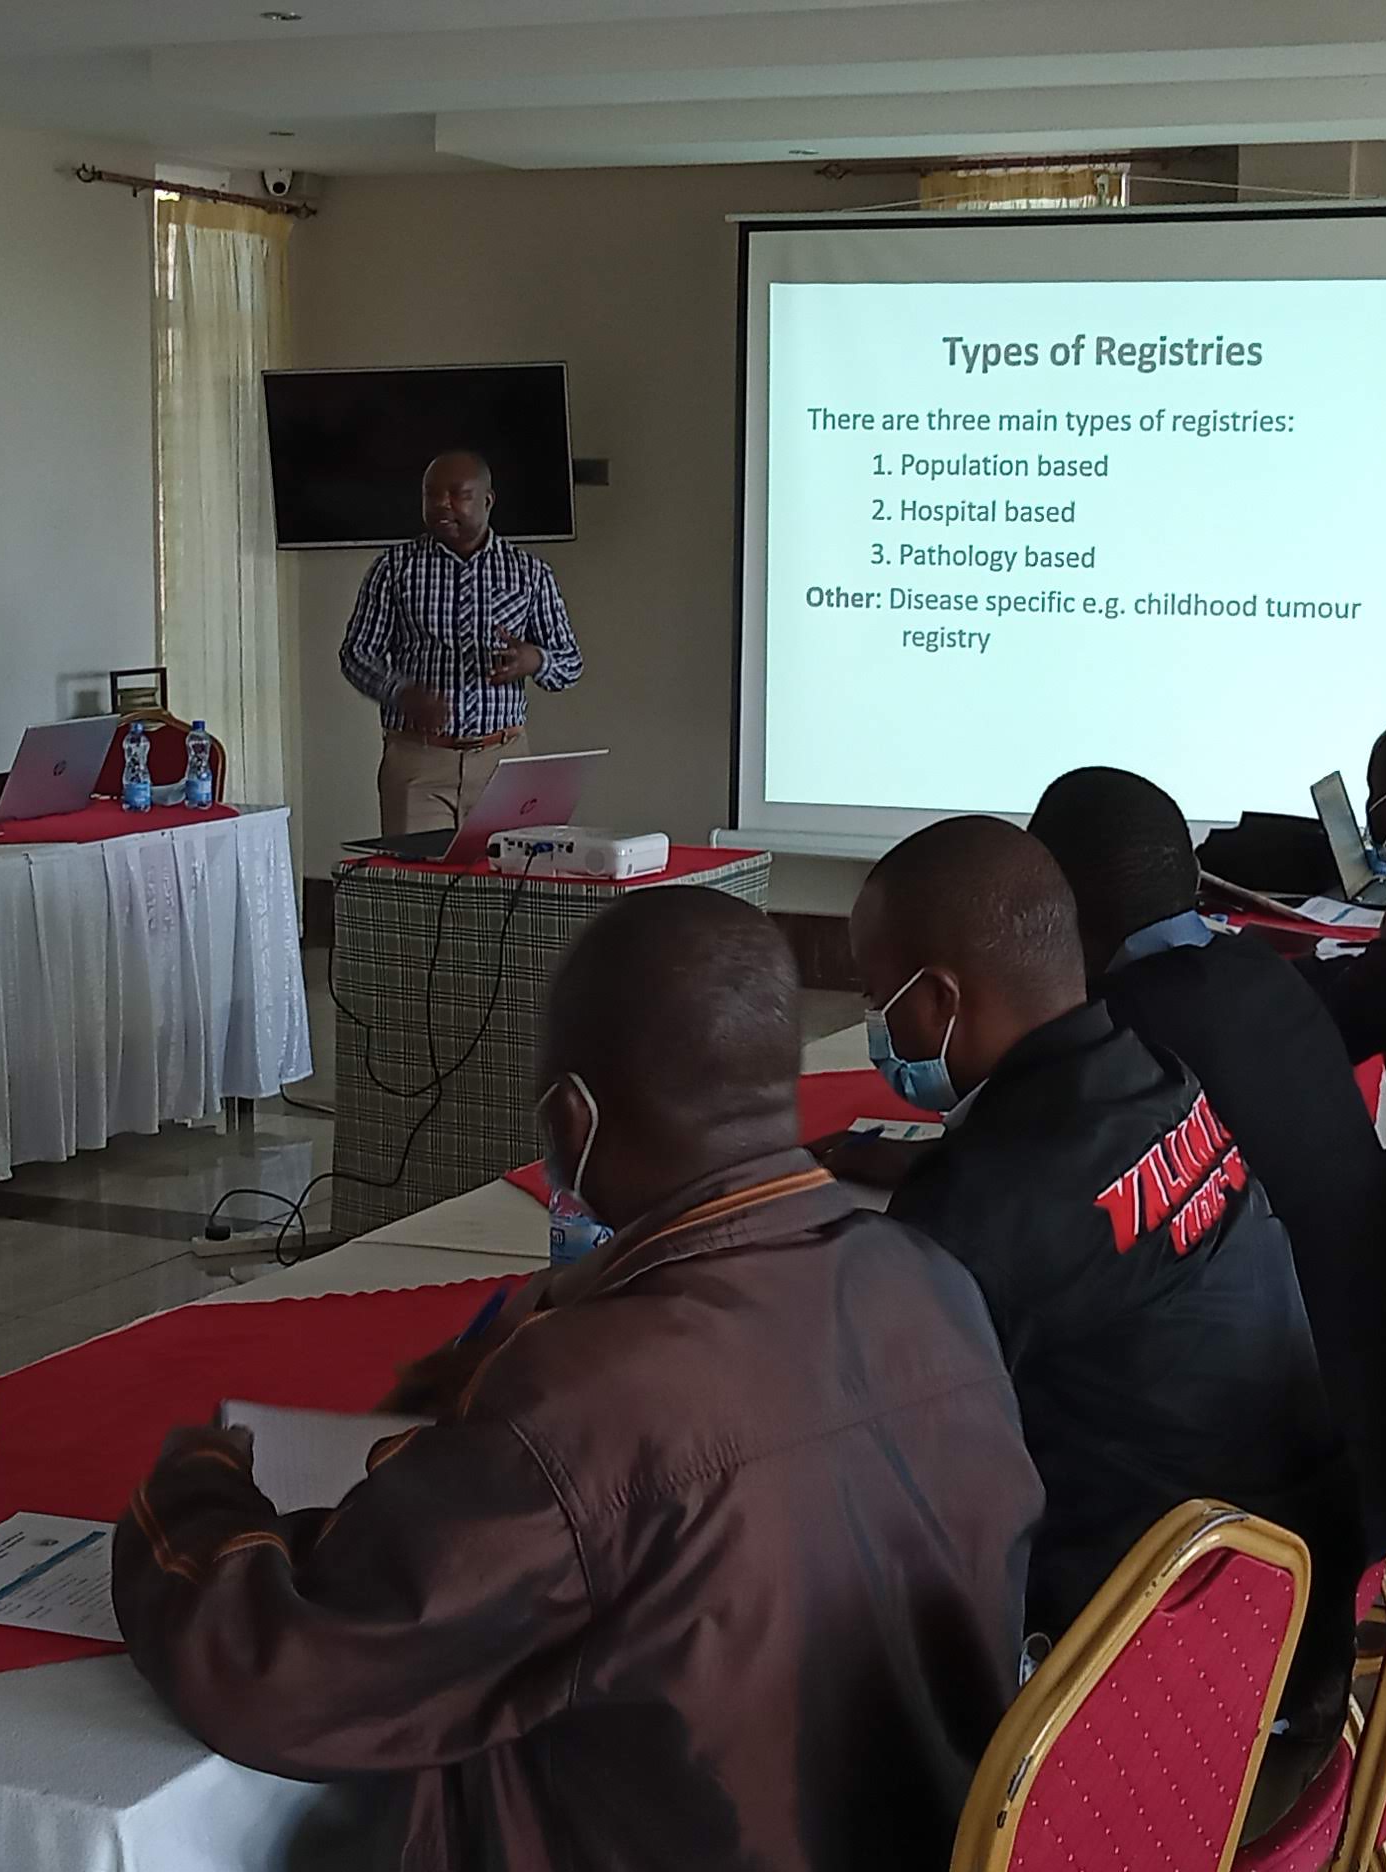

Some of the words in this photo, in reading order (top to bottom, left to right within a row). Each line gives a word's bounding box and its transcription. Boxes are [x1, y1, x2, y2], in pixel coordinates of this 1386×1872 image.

[941, 336, 1040, 375] Types
[1049, 333, 1087, 367] of
[1095, 334, 1263, 374] Registries
[806, 407, 876, 431] There
[881, 413, 920, 432] are
[925, 407, 991, 432] three
[998, 408, 1058, 432] main
[1064, 410, 1132, 438] types
[1139, 407, 1167, 433] of
[1171, 409, 1295, 438] registries:
[872, 453, 893, 476] 1.
[900, 452, 1029, 482] Population
[1037, 453, 1109, 478] based
[871, 498, 893, 521] 2.
[900, 498, 997, 528] Hospital
[1004, 499, 1076, 524] based
[870, 542, 892, 566] 3.
[899, 543, 1019, 573] Pathology
[1024, 544, 1096, 569] based
[805, 585, 882, 610] Other:
[889, 587, 979, 612] Disease
[984, 590, 1076, 618] specific
[1082, 596, 1126, 620] e.g.
[1133, 591, 1258, 618] childhood
[1264, 597, 1363, 620] tumour
[902, 625, 992, 655] registry
